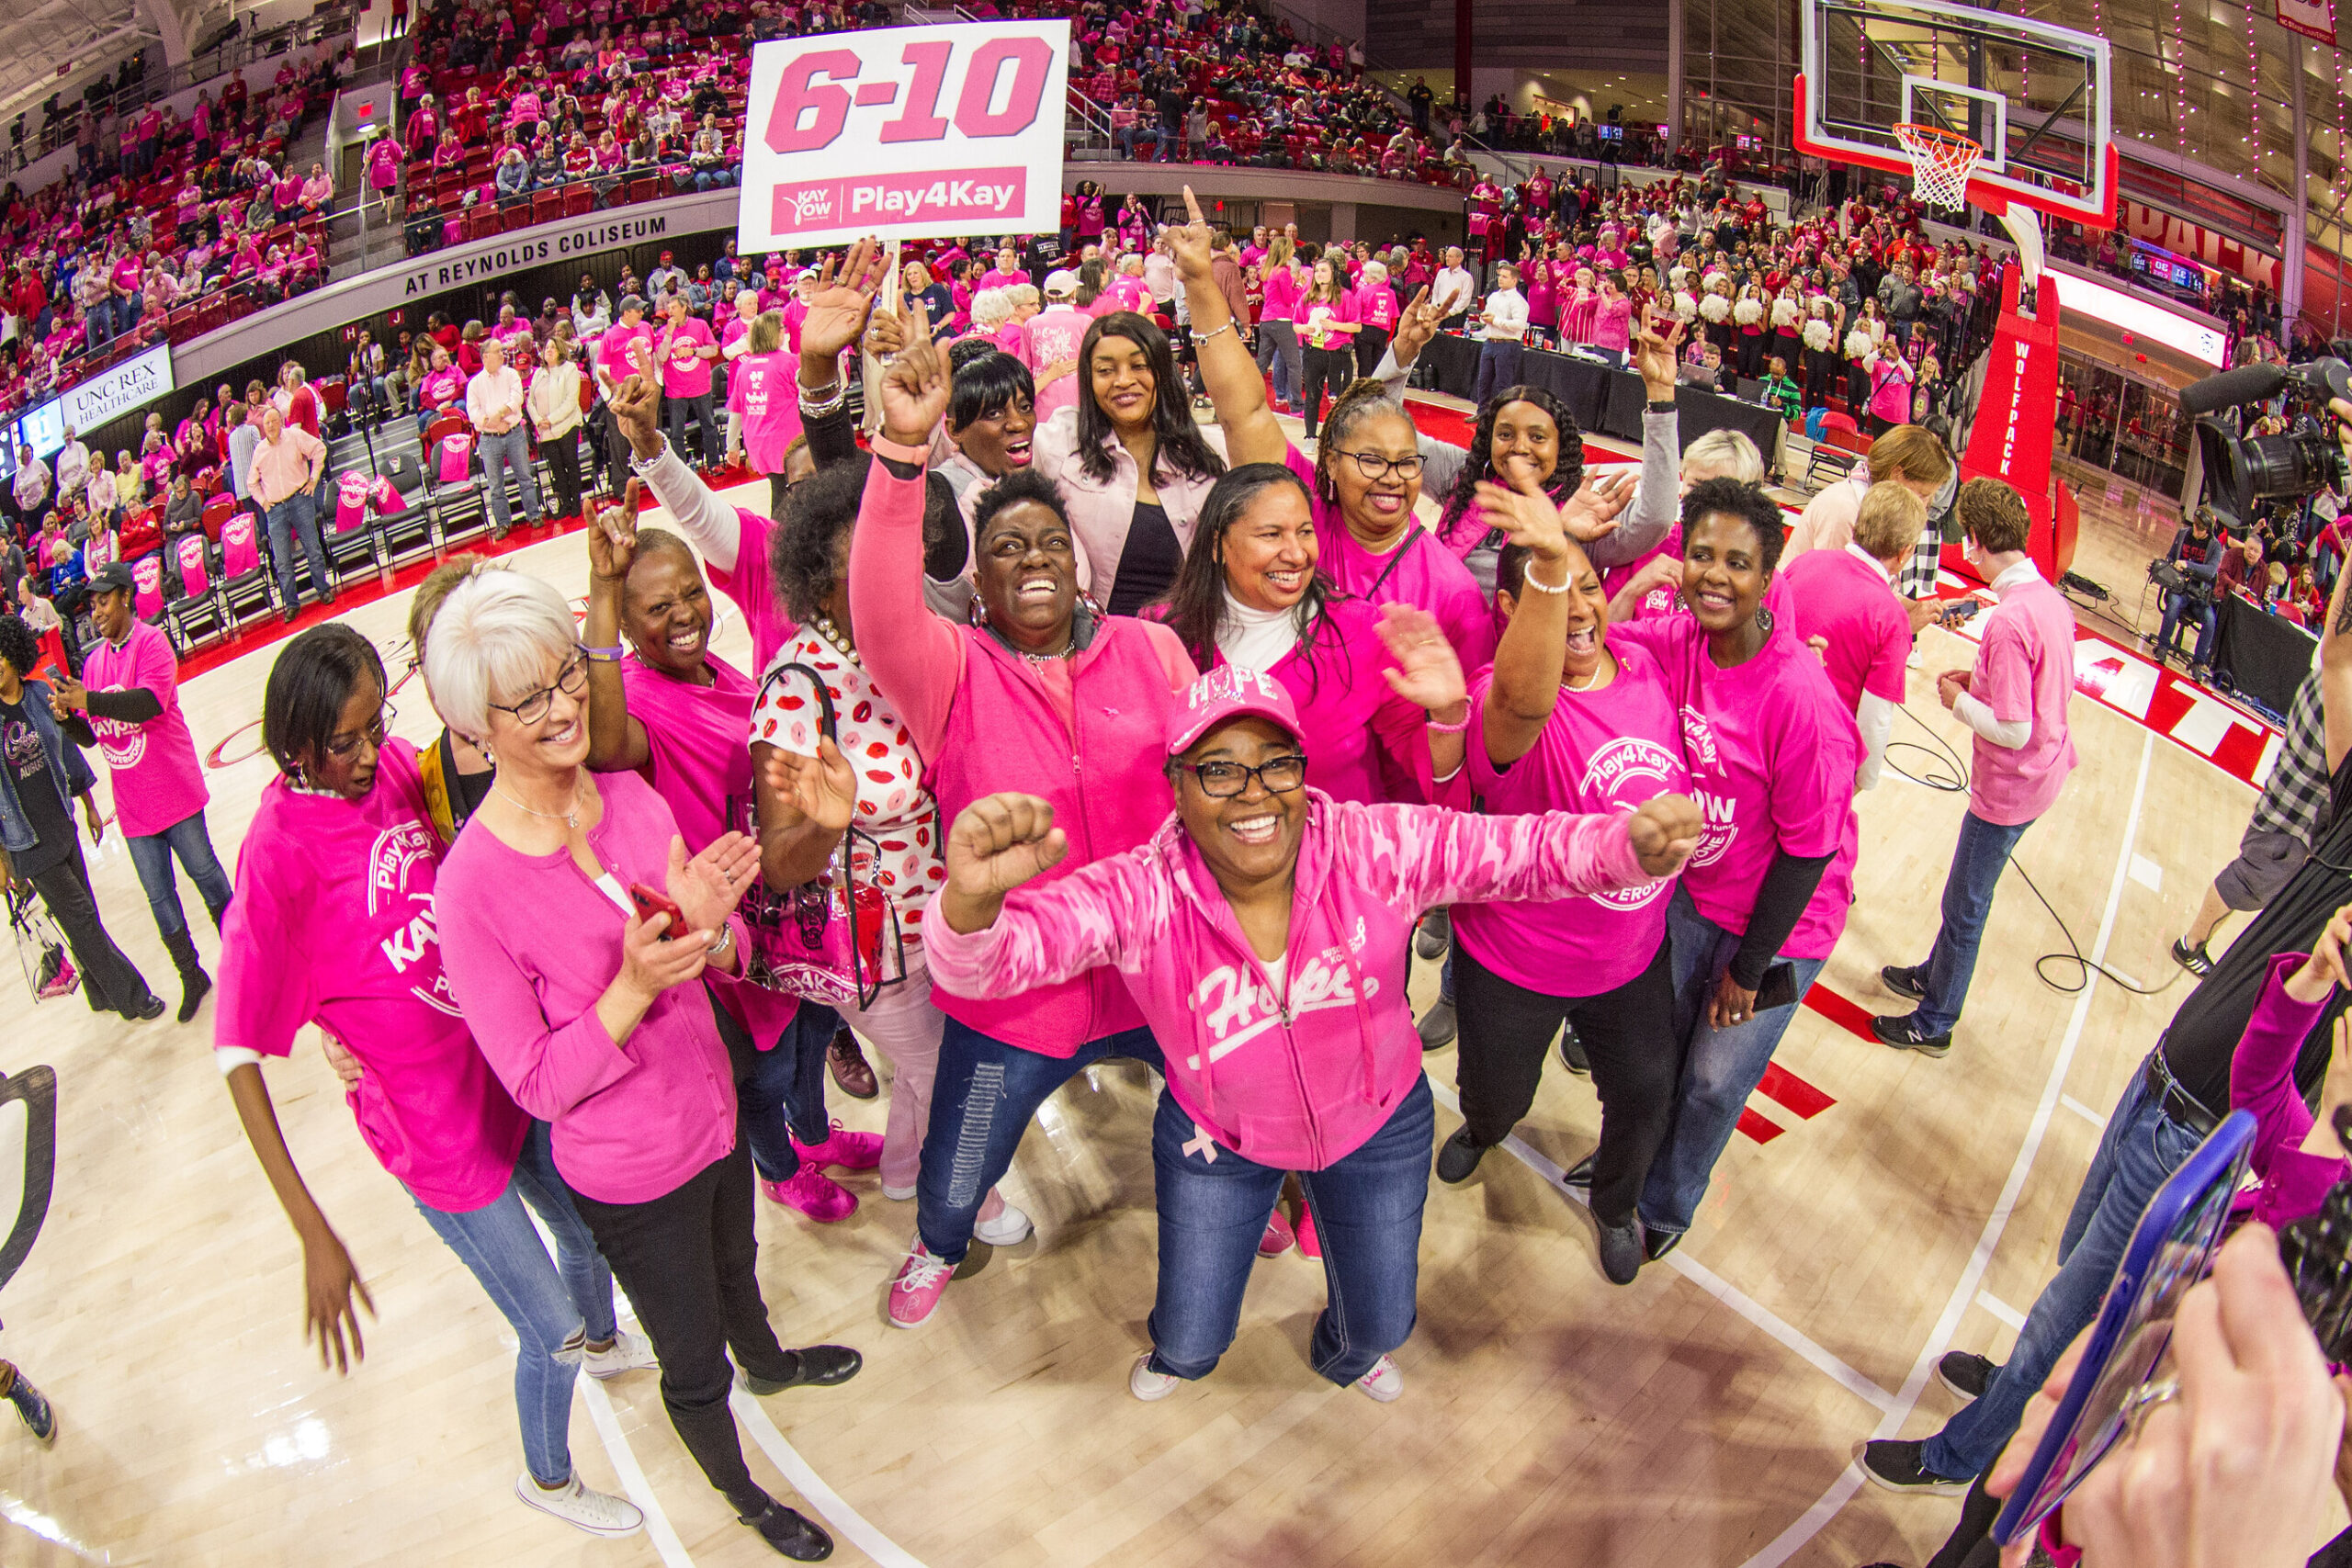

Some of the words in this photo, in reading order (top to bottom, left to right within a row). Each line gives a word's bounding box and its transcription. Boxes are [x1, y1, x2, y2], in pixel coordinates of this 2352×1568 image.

[763, 36, 1055, 154] 6-10
[782, 197, 832, 227] YOW
[797, 188, 829, 203] KAY
[851, 179, 1016, 217] Play4Kay
[404, 273, 429, 296] AT
[438, 241, 549, 285] REYNOLDS
[559, 217, 666, 254] COLISEUM
[345, 328, 356, 339] H
[393, 311, 401, 323] J
[76, 379, 115, 412] UNC
[119, 359, 156, 390] REX
[79, 378, 159, 425] HEALTHCARE
[2000, 340, 2030, 476] WOLFPACK
[1589, 744, 1673, 797] Play4Kay
[377, 829, 435, 891] PlayKay
